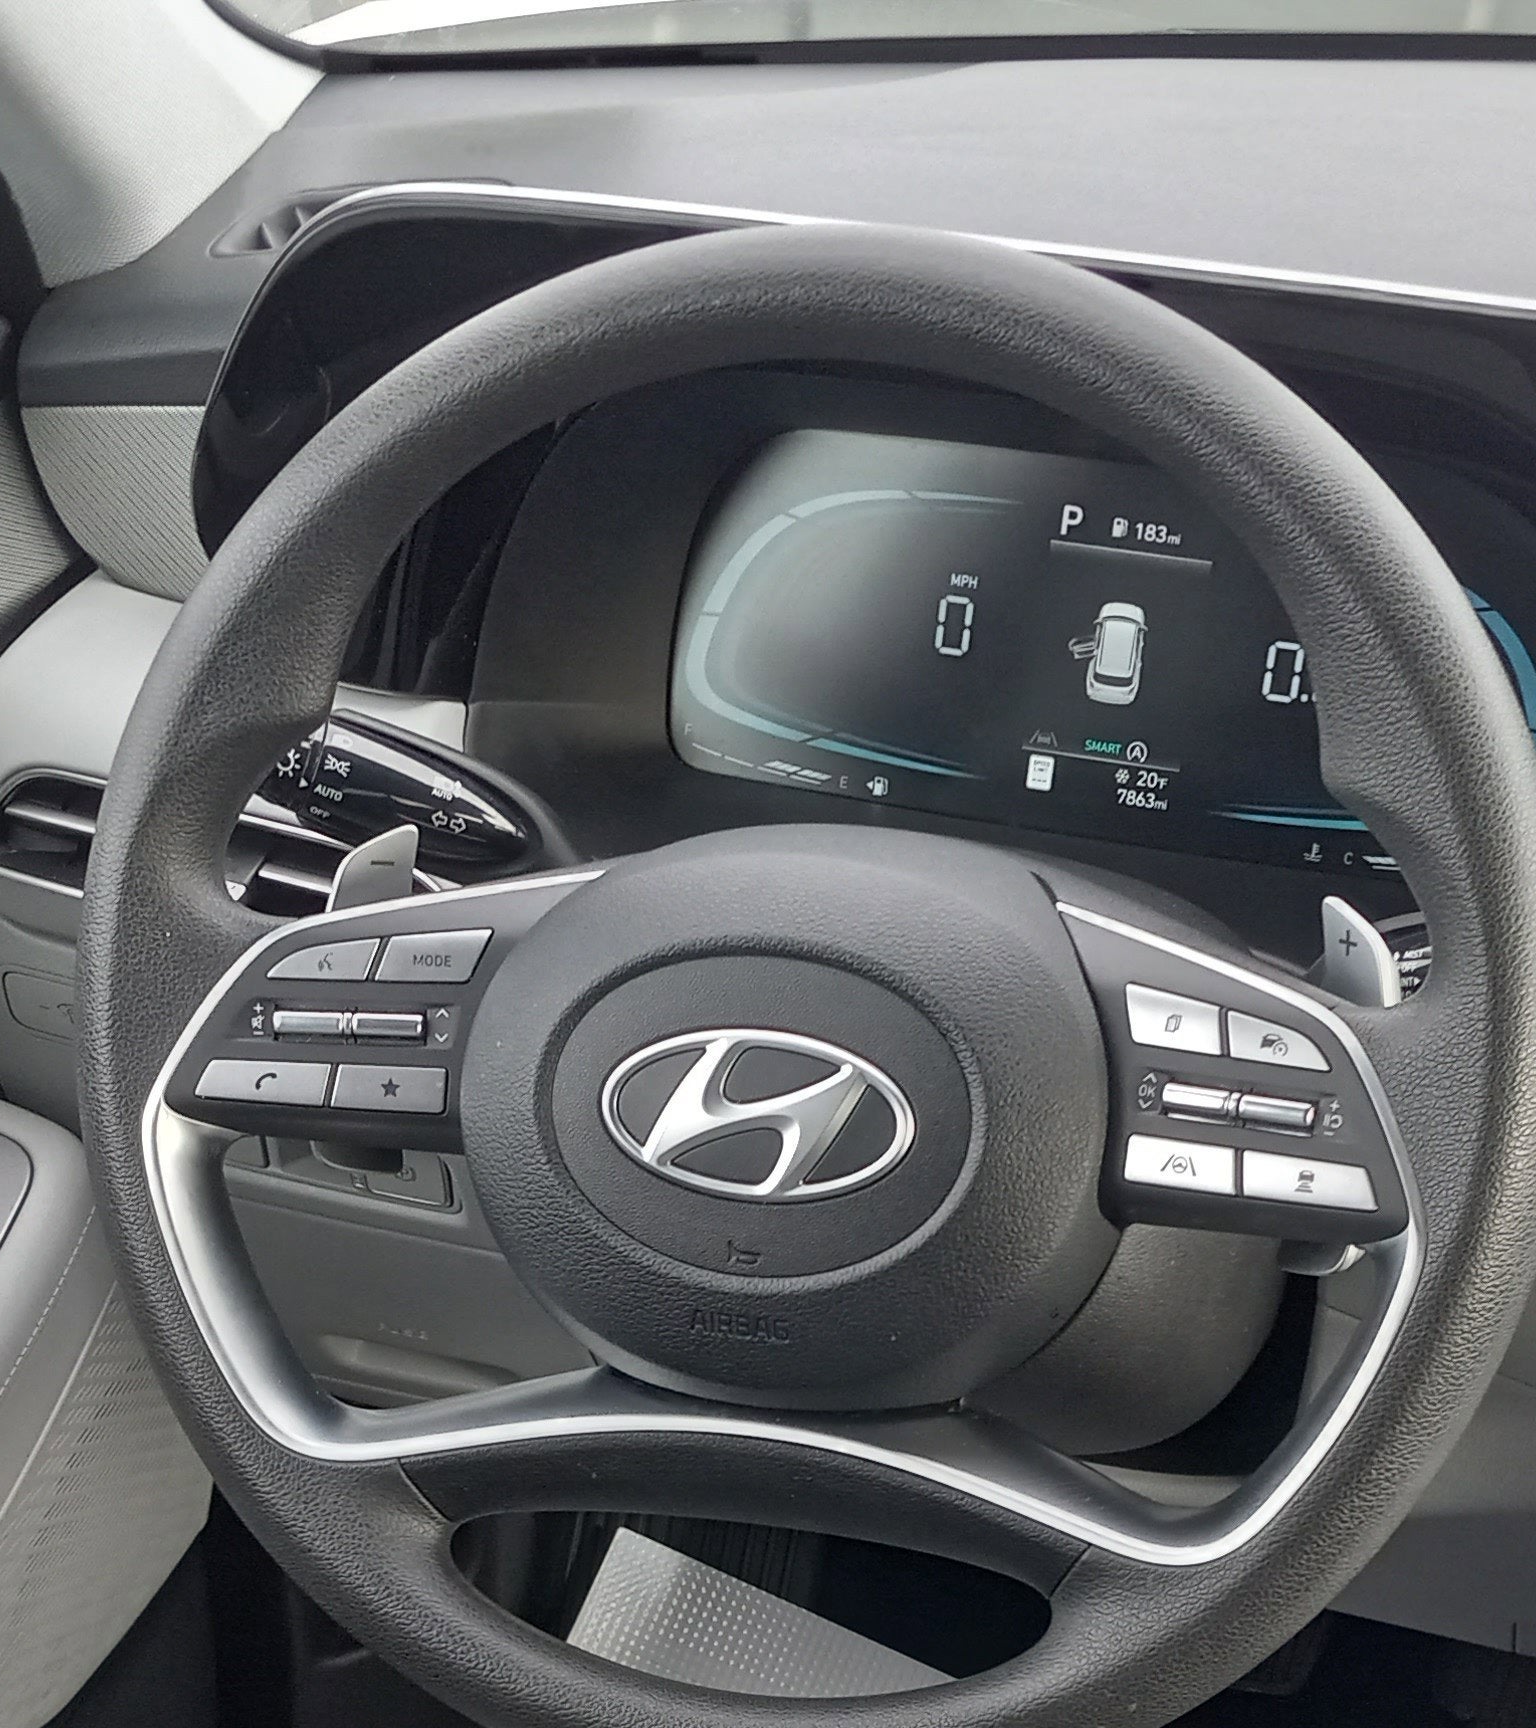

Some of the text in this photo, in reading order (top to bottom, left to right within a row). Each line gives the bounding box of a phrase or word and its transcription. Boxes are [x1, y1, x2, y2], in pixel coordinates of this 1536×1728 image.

[1060, 504, 1085, 536] P
[950, 573, 979, 589] MPH
[934, 594, 975, 657] 0
[1084, 739, 1122, 755] SMART
[314, 784, 344, 802] AUTO
[1343, 852, 1354, 865] C
[413, 953, 452, 968] MODE
[1138, 1084, 1157, 1098] OK
[690, 1308, 790, 1342] AIRBAG
